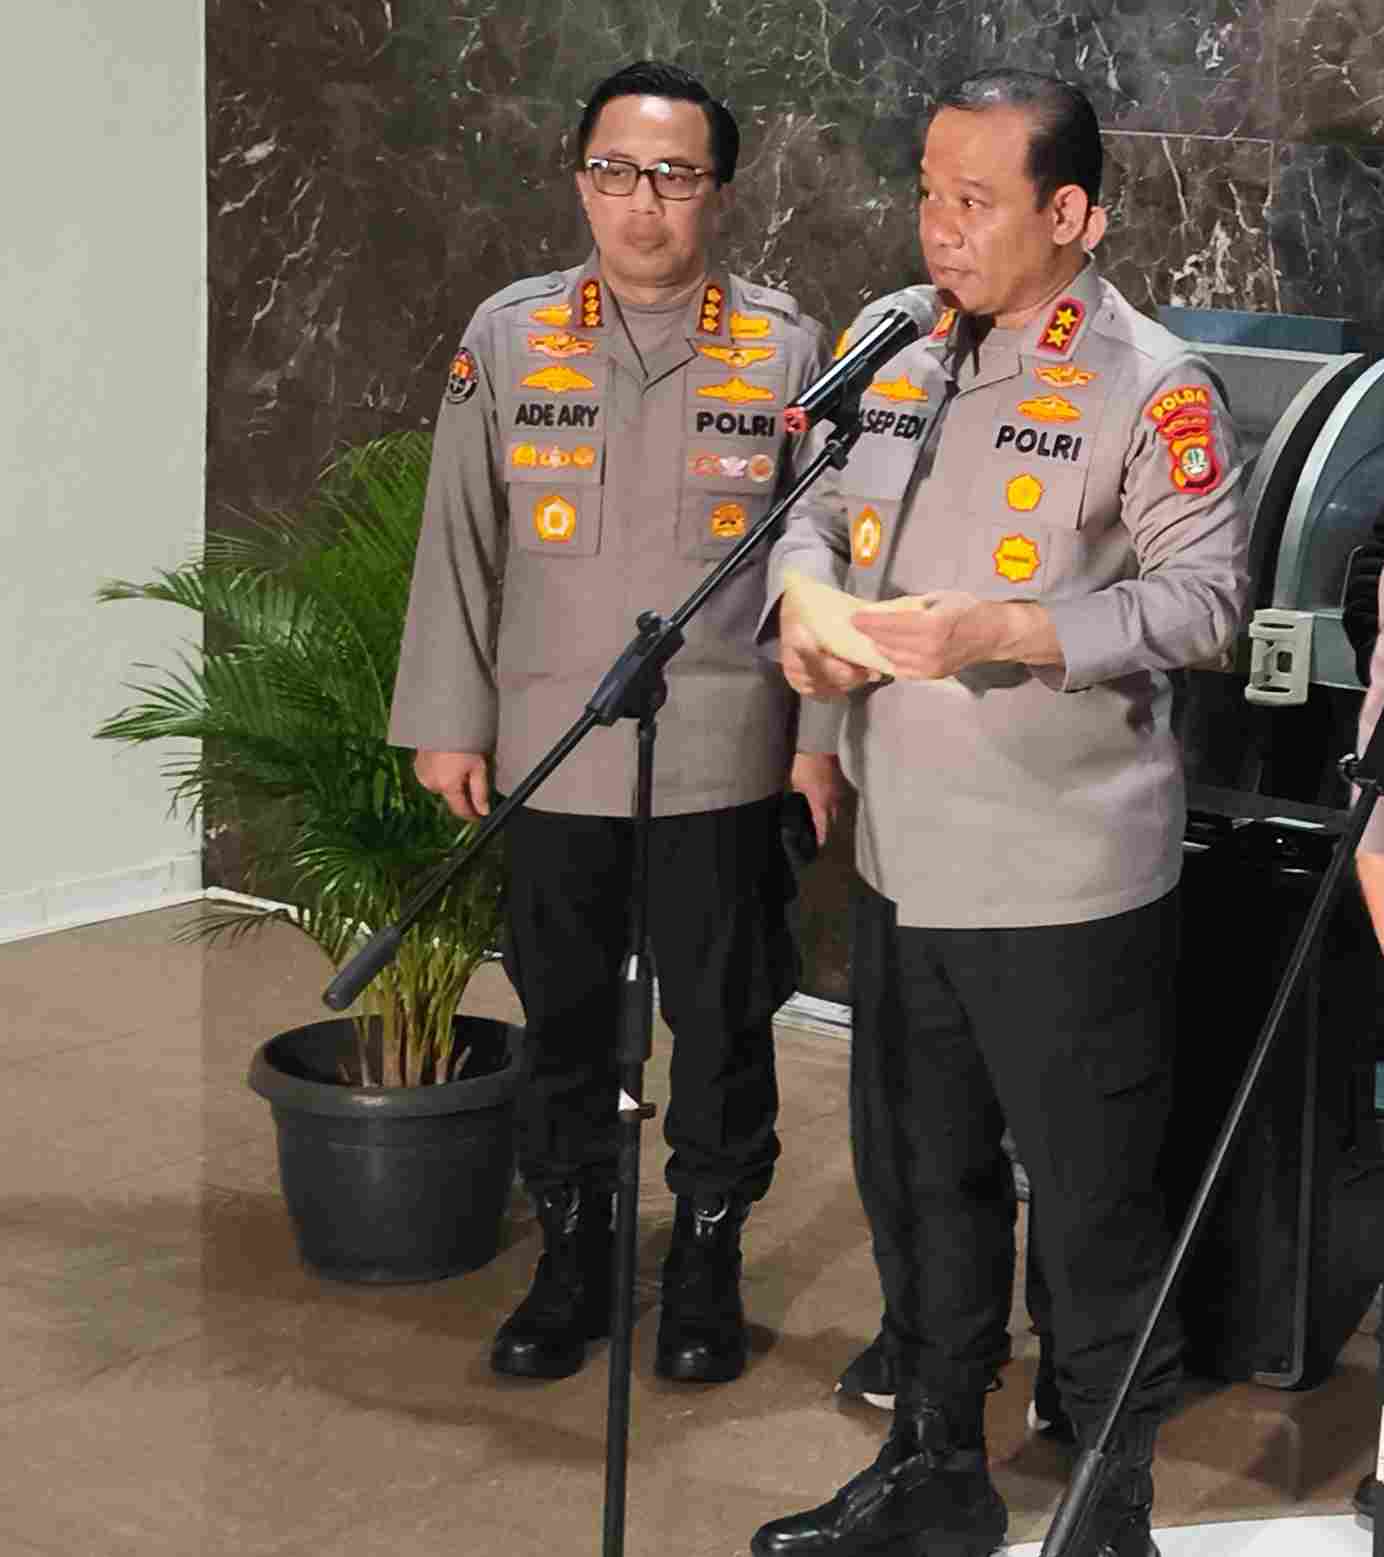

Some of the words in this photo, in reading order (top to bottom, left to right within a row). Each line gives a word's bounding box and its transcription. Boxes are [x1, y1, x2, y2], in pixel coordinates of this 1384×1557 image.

[514, 403, 555, 427] ADE
[557, 403, 599, 428] ARY
[1151, 387, 1207, 419] POLDA
[695, 411, 775, 437] POLRI
[860, 408, 896, 434] SEP
[894, 413, 928, 440] EDI
[995, 424, 1082, 461] POLRI
